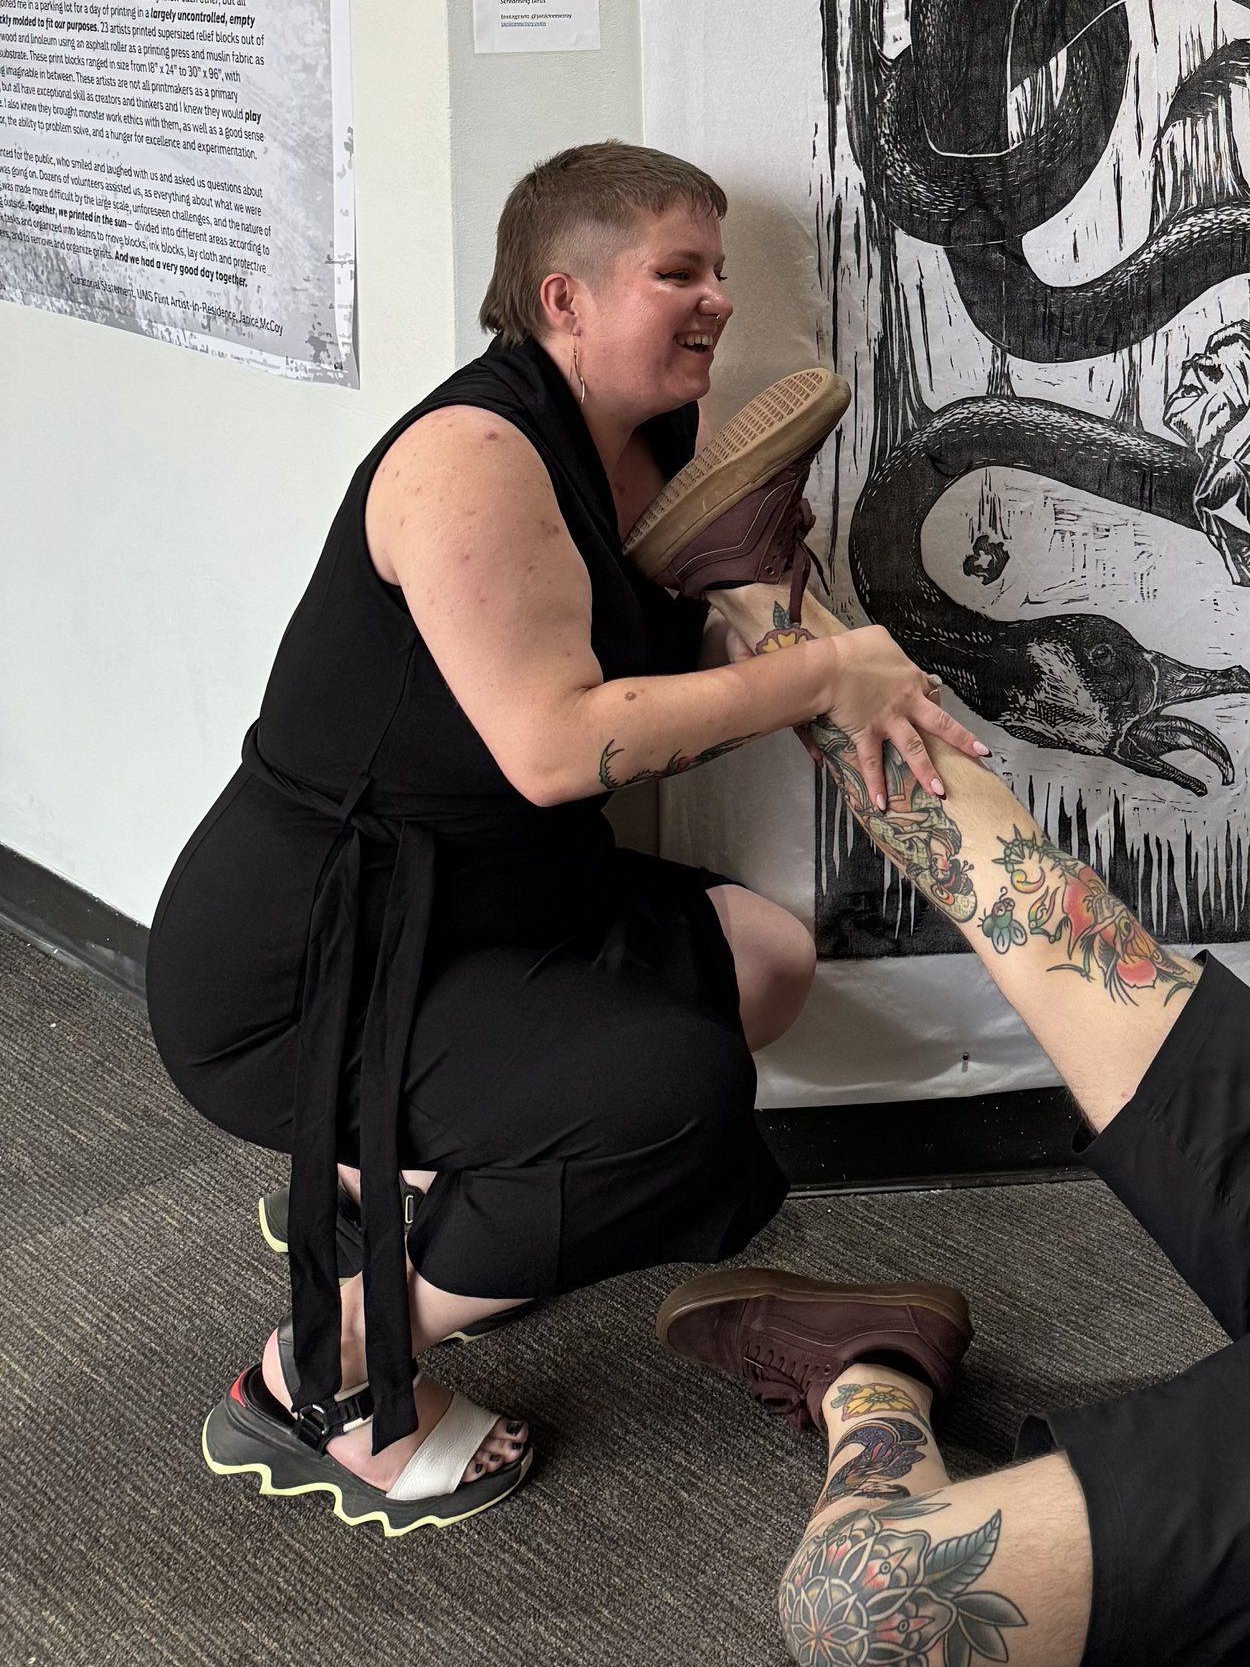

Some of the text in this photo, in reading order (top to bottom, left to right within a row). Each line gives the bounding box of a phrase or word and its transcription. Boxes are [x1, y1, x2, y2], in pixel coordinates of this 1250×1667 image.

[150, 7, 176, 23] largely
[229, 15, 255, 29] empty
[101, 21, 108, 33] 23
[196, 30, 214, 42] relief
[216, 31, 240, 44] blocks
[241, 34, 255, 45] out
[256, 34, 264, 46] of
[171, 47, 264, 65] press and muslin fabric as
[178, 64, 187, 77] to
[225, 70, 240, 82] with
[195, 87, 203, 96] as
[211, 87, 238, 103] primary
[184, 102, 203, 116] knew
[204, 105, 220, 120] they
[221, 108, 244, 120] would
[245, 110, 261, 125] play
[182, 123, 191, 132] as
[192, 122, 207, 134] well
[209, 126, 217, 135] as
[224, 126, 242, 140] good
[244, 130, 264, 142] sense
[182, 139, 196, 150] and
[174, 174, 263, 198] asked us questions about
[192, 194, 261, 216] about what we were
[69, 206, 93, 222] printed
[176, 227, 207, 242] different
[209, 235, 228, 246] areas
[229, 238, 261, 256] according
[262, 244, 270, 255] to
[214, 217, 227, 227] and
[228, 218, 240, 229] the
[241, 220, 263, 235] nature
[264, 226, 272, 237] of
[115, 250, 128, 262] And
[130, 256, 140, 264] we
[140, 254, 154, 267] had
[162, 262, 178, 274] very
[179, 265, 198, 276] good
[200, 266, 214, 282] day
[187, 245, 267, 274] lay cloth and protective
[137, 287, 153, 301] UMS
[260, 318, 283, 336] McCoy
